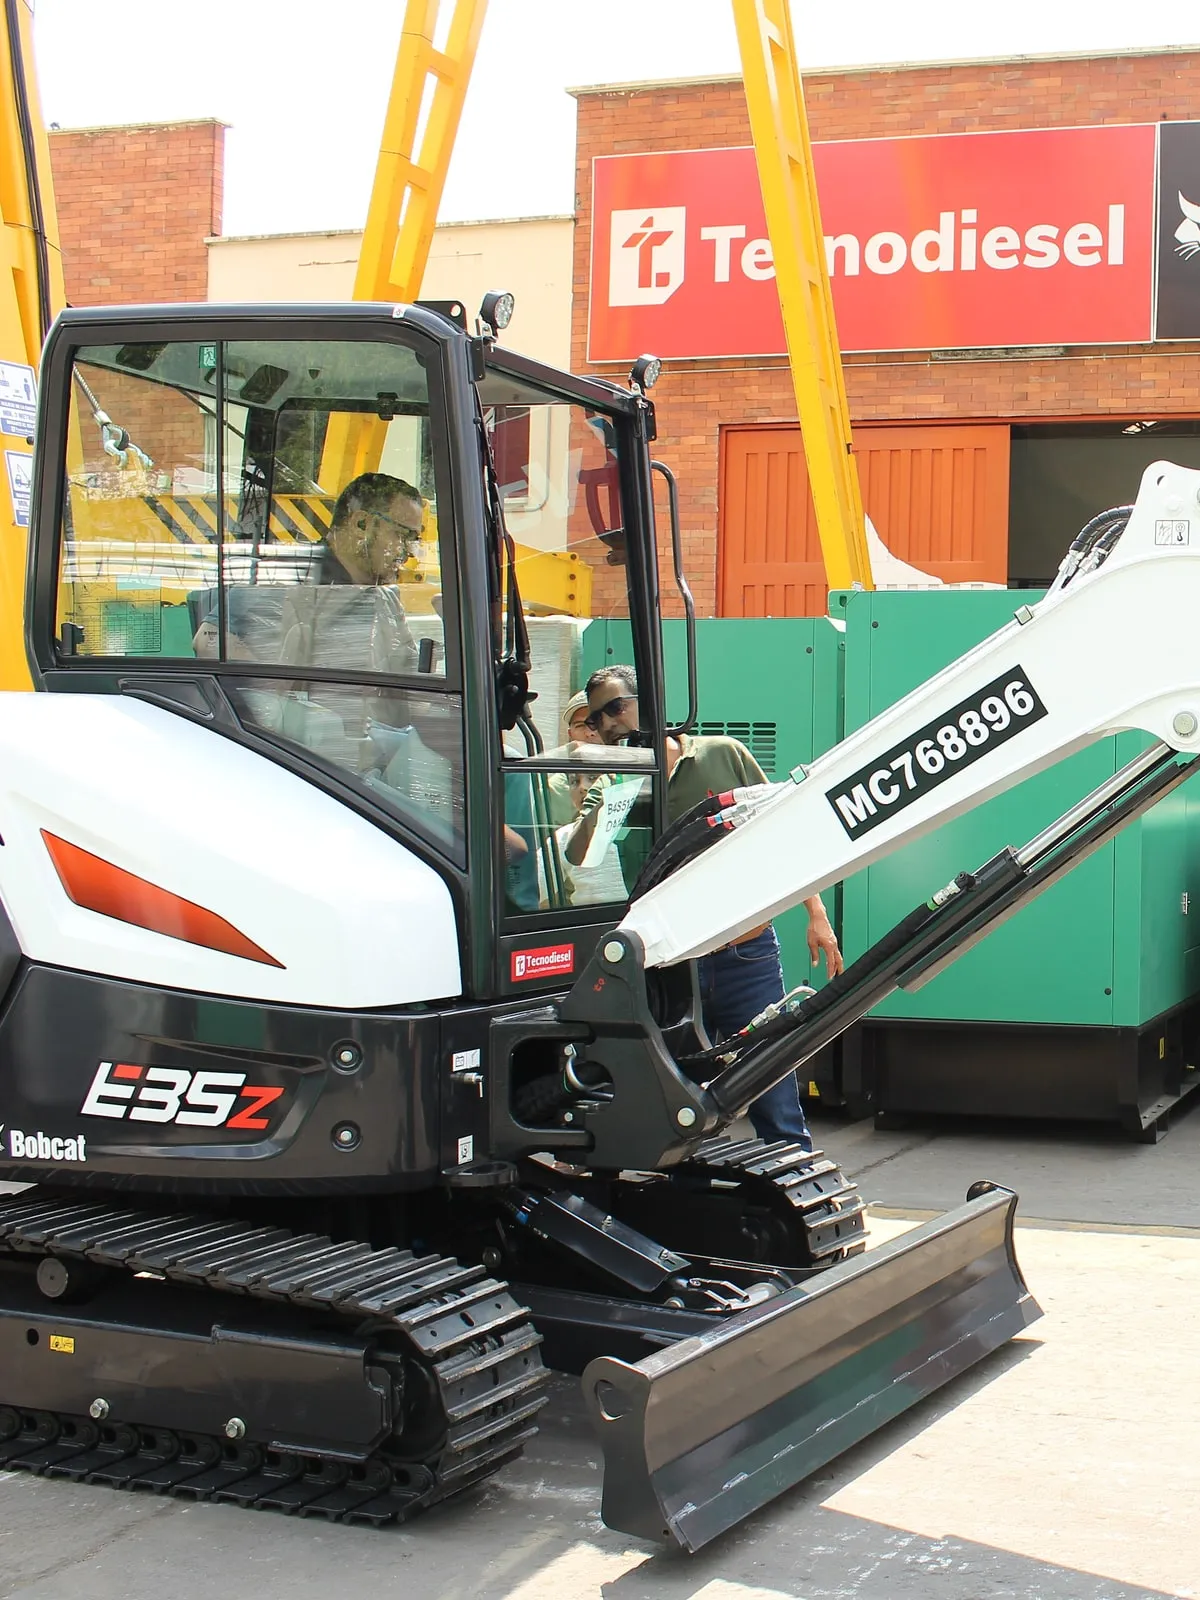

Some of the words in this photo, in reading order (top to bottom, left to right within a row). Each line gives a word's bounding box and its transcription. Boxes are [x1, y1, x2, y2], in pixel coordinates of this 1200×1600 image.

[700, 204, 1124, 283] Tenodiesel
[834, 681, 1035, 829] MC768896
[526, 949, 571, 967] Tecnodiesel
[10, 1129, 87, 1162] Bobcat
